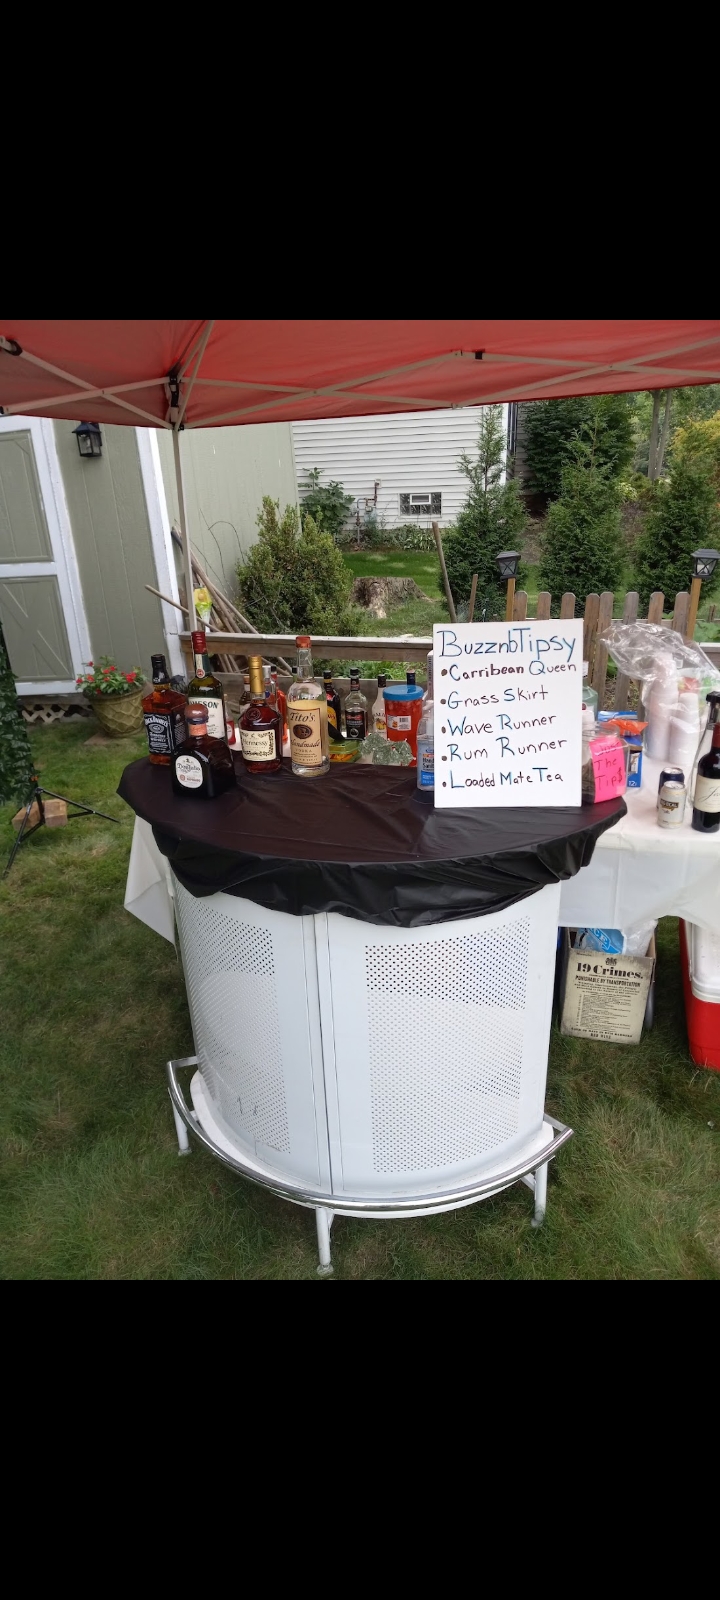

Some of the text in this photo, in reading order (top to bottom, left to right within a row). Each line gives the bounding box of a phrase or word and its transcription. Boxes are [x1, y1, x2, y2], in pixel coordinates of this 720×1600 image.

[449, 664, 524, 681] Carribean
[529, 660, 576, 676] Queen
[447, 685, 548, 709] Grass Skirt
[447, 713, 557, 736] Wave Runner
[447, 737, 567, 761] Rum Runner
[593, 759, 617, 770] The
[450, 770, 495, 788] Loaded
[532, 767, 563, 782] Tea
[577, 963, 591, 973] 19
